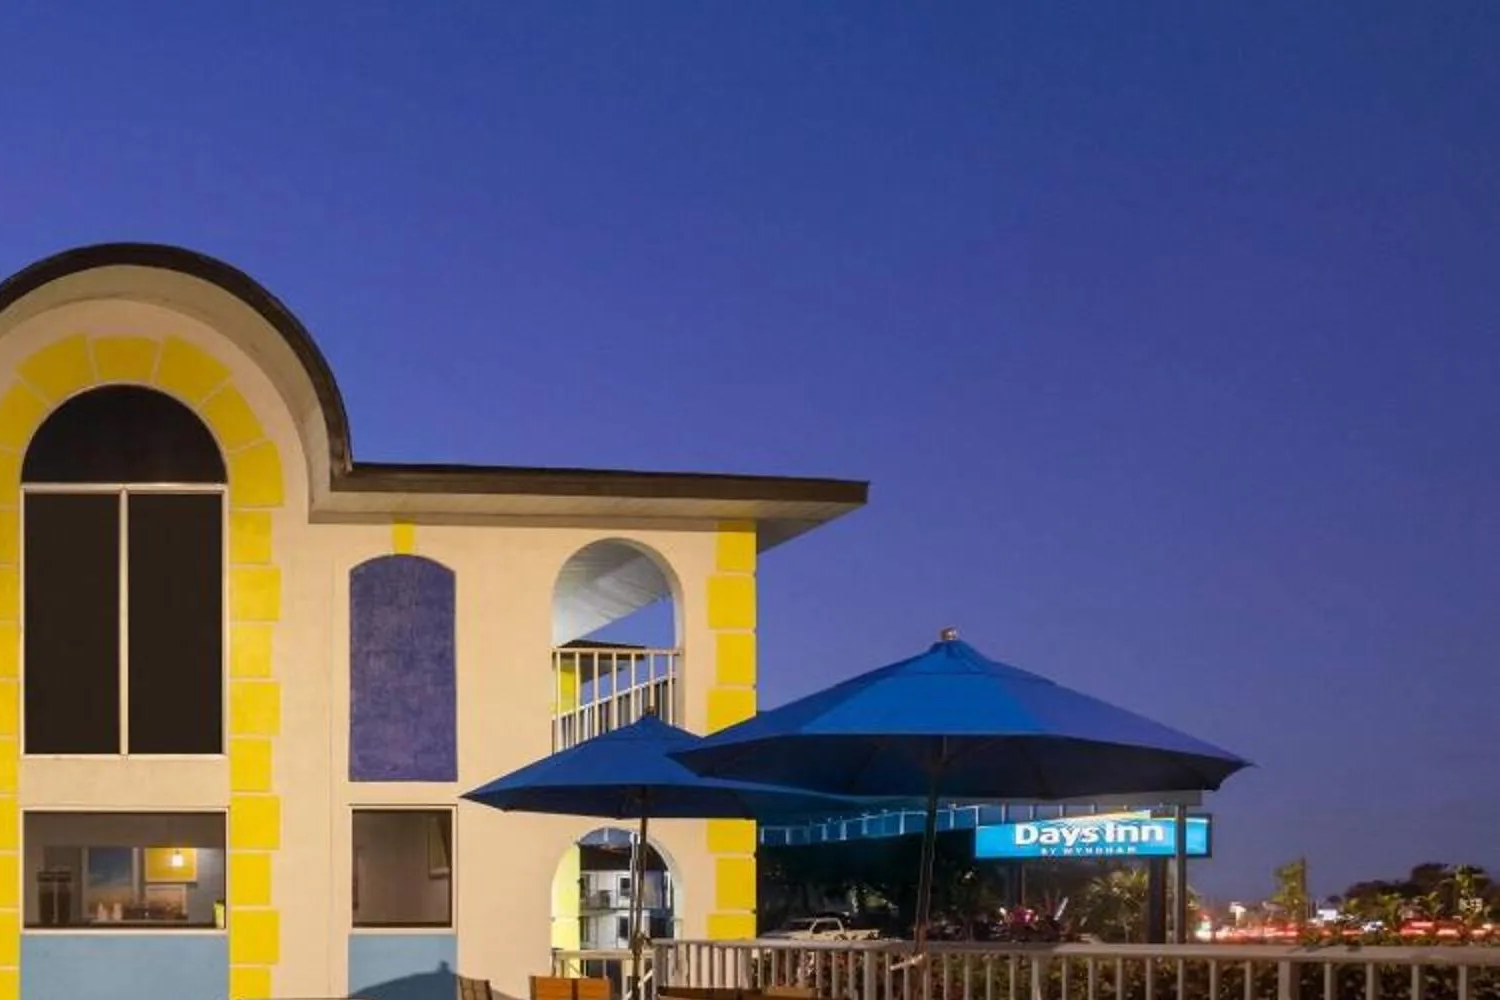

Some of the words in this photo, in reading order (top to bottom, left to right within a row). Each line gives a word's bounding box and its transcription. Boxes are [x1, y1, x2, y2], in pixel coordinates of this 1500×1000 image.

[1014, 822, 1100, 846] Days
[1105, 821, 1164, 843] Inn
[1040, 847, 1057, 855] BY
[1063, 846, 1137, 855] WYNDHAM
